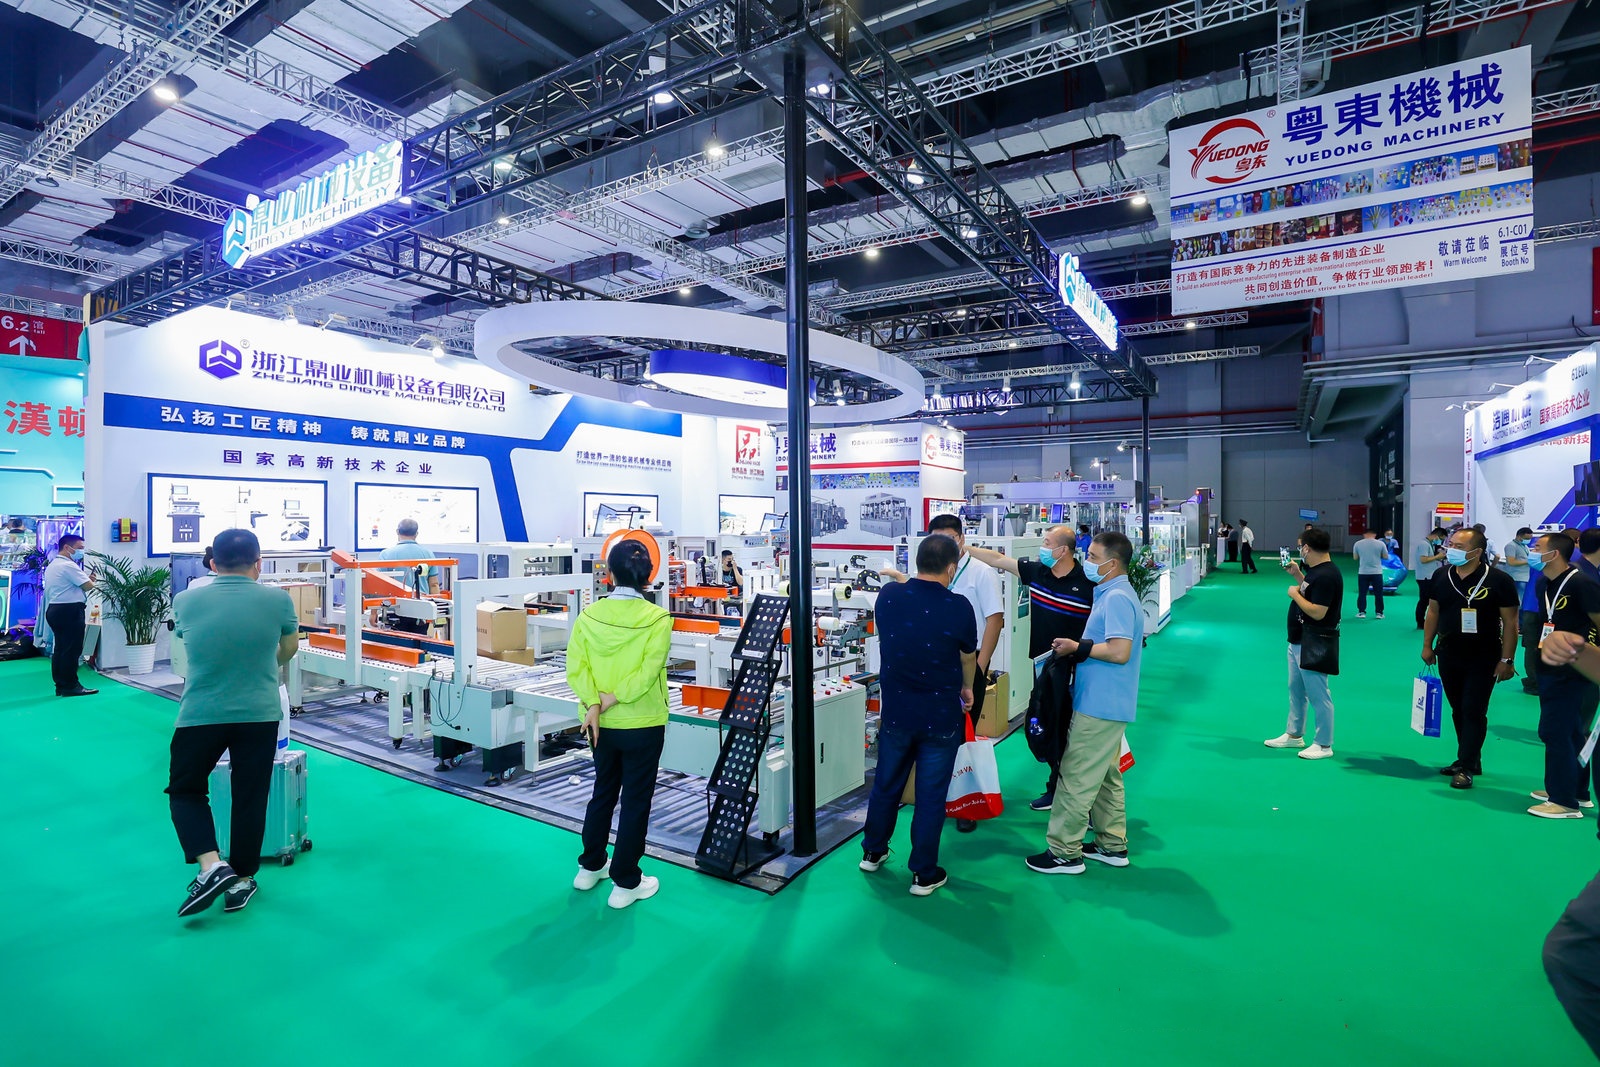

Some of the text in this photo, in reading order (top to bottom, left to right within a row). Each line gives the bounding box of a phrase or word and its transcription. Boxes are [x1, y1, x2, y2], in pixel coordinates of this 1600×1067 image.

[1281, 62, 1504, 146] 粤東機械
[1285, 112, 1505, 167] YUEDONG MACHINERY
[301, 182, 393, 231] MACHINERY
[1438, 235, 1490, 257] 敬请莅临
[1498, 223, 1528, 238] 6.1-C01
[1176, 243, 1386, 284] 打造有国际竞争力的先进装备制造企业
[1443, 254, 1488, 268] Warm Welcome
[1500, 243, 1530, 258] 展位号
[1501, 256, 1530, 267] Booth No
[1199, 280, 1220, 289] advanced
[1220, 277, 1244, 287] equipment
[1244, 271, 1278, 283] manufacturing
[1277, 268, 1302, 278] enterprise
[1302, 266, 1314, 274] with
[1313, 262, 1345, 273] international
[1345, 257, 1386, 268] competitiveness
[1318, 284, 1337, 293] strive
[1371, 275, 1406, 286] industrial
[1407, 272, 1433, 282] leader!
[1, 314, 30, 333] 6.2
[251, 349, 505, 406] 浙江鼎业机械设备有限公司
[251, 370, 334, 389] ZHEJIANG
[338, 383, 391, 398] DINGYE
[394, 391, 463, 407] MACHINERY
[1540, 388, 1590, 425] 国家高新技术企业
[160, 405, 467, 450] 弘扬工匠精神 铸就鼎业品牌
[223, 449, 433, 476] 国家高新技术企业
